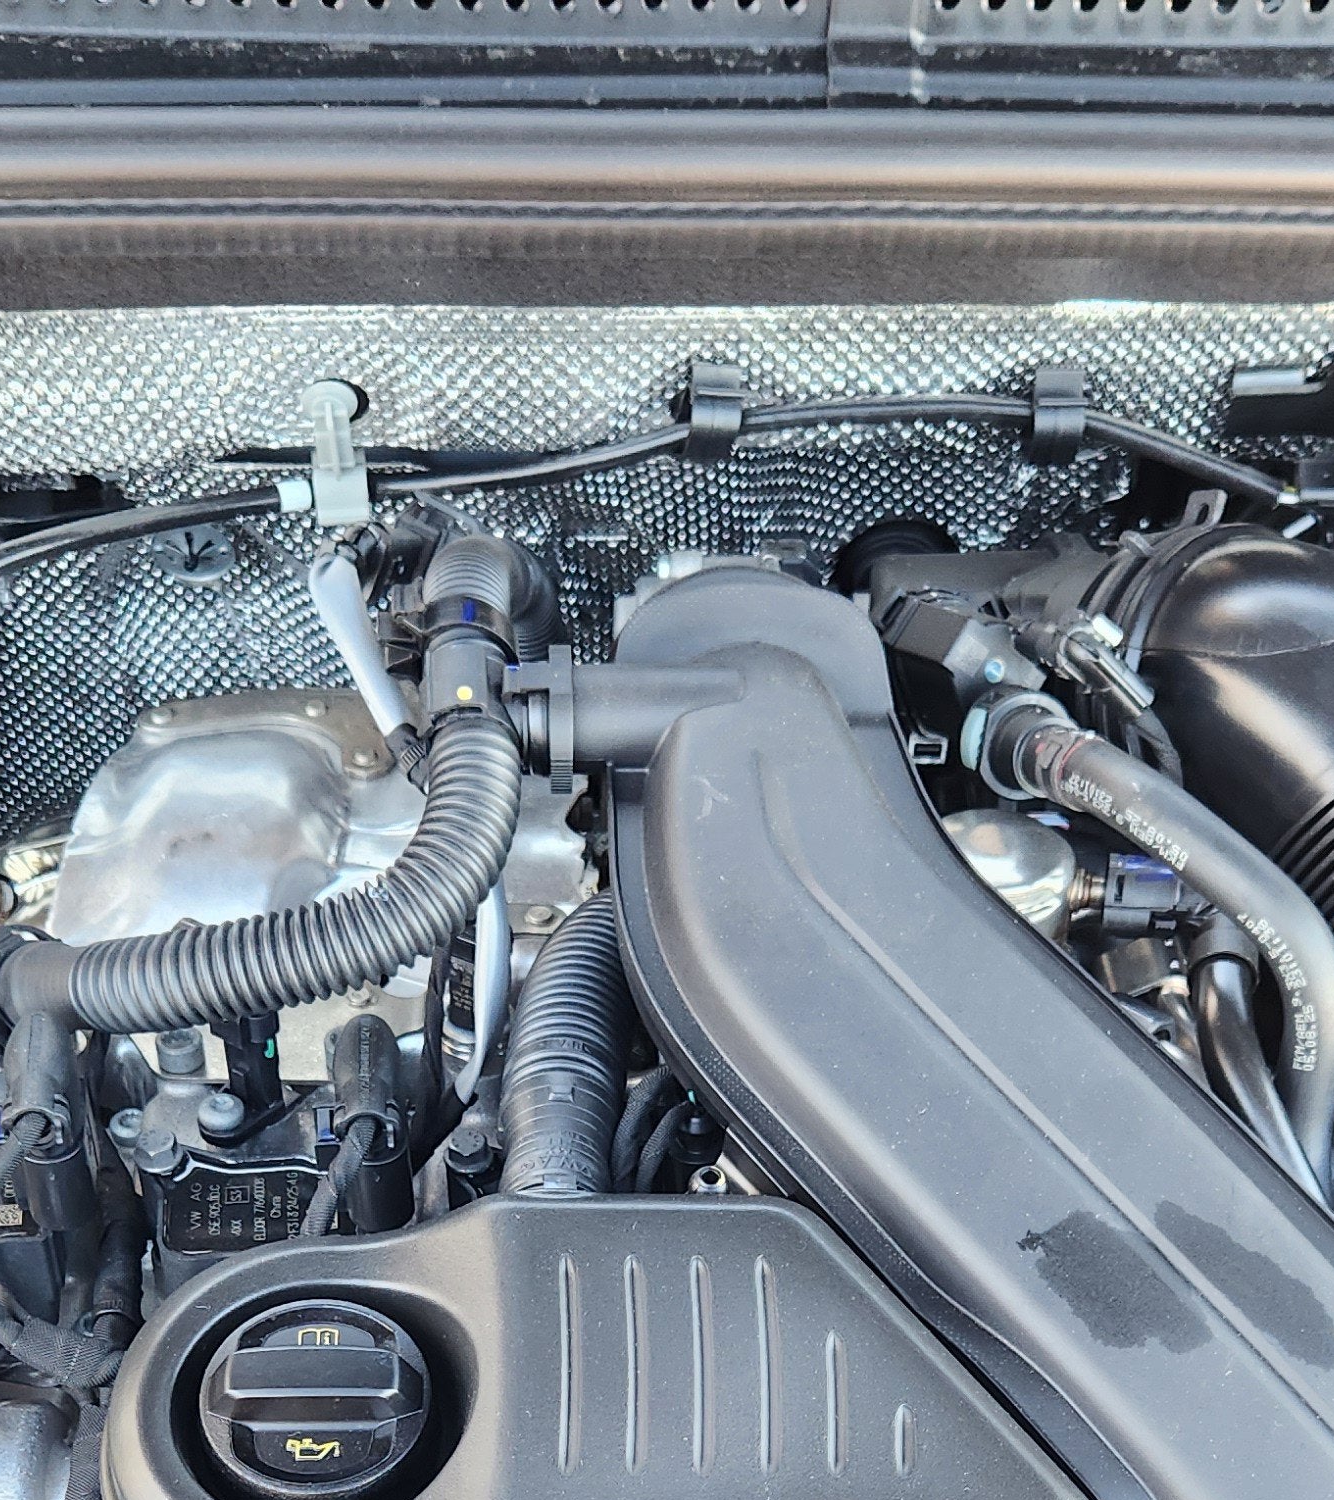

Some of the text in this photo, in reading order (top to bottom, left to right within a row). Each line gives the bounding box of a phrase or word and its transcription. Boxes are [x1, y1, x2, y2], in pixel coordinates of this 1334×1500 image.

[189, 1182, 203, 1231] VW AG
[230, 1189, 243, 1202] S3
